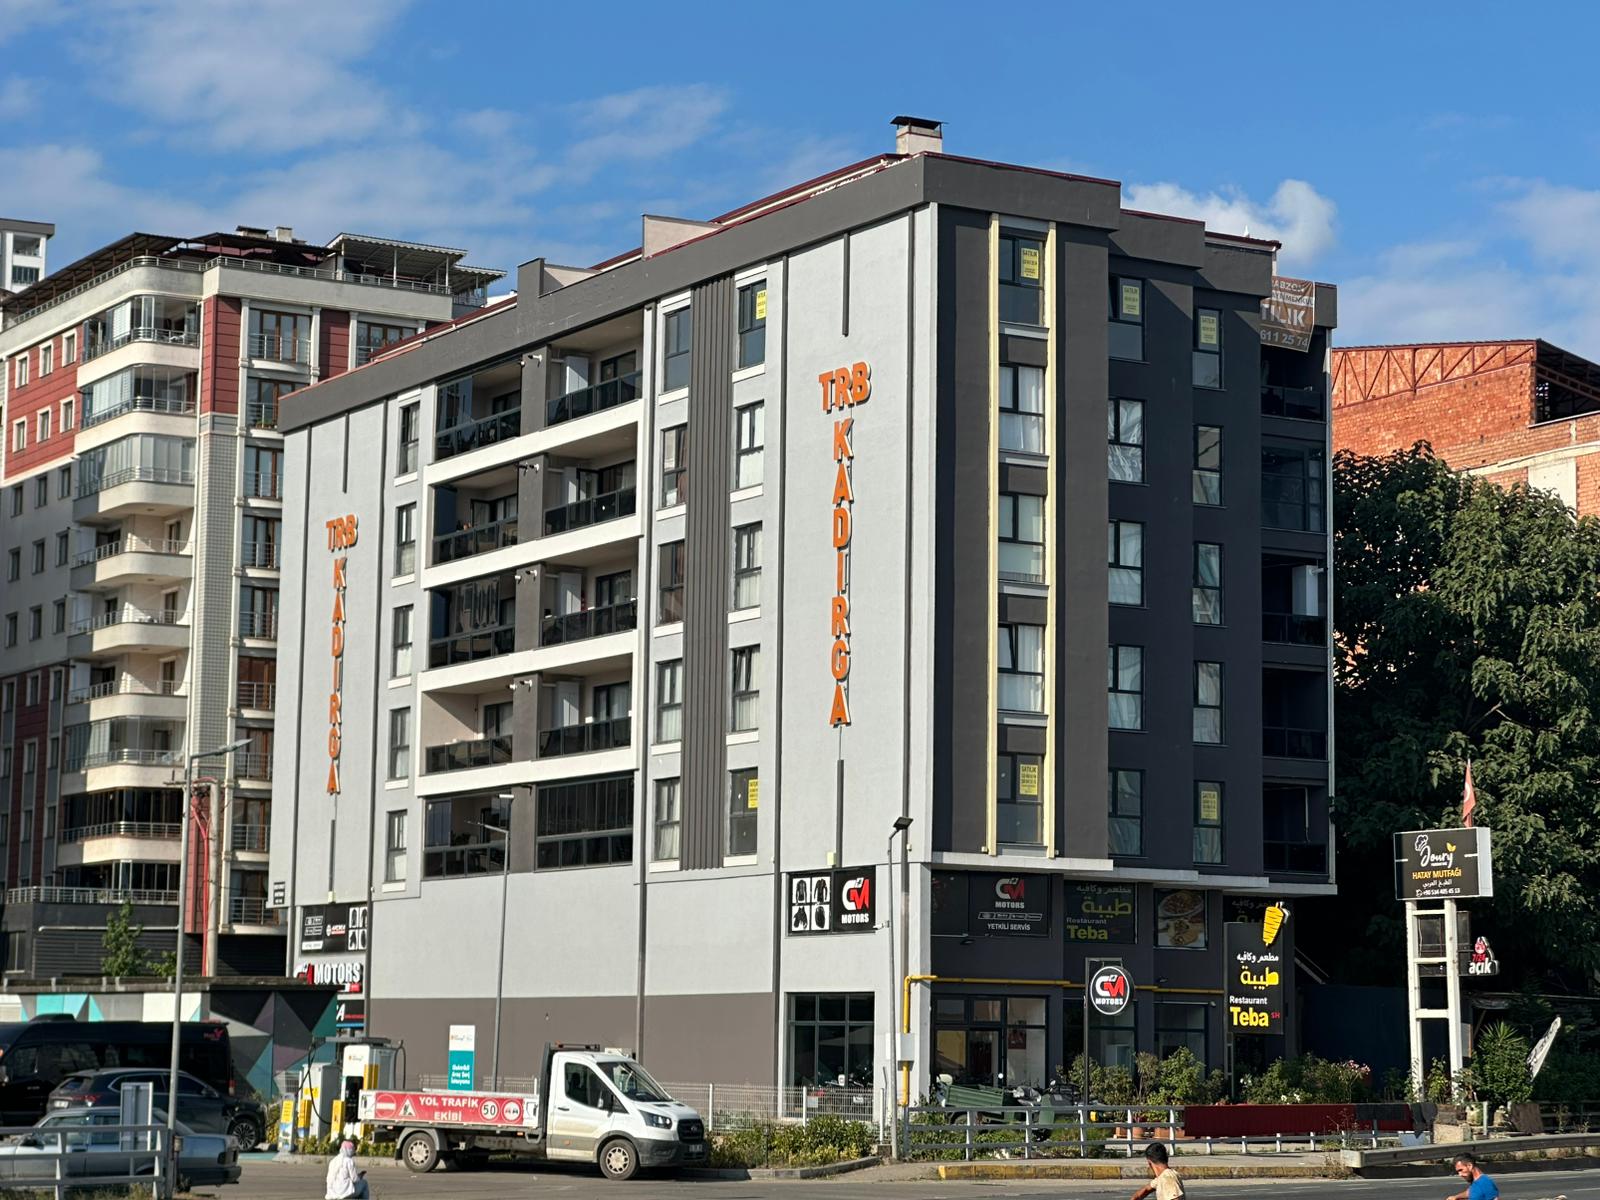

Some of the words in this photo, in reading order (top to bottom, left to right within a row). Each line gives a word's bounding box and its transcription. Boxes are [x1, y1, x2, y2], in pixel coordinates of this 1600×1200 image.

[818, 361, 871, 414] TRB
[326, 514, 359, 552] TRB
[830, 417, 854, 728] KADIRGA
[1412, 871, 1431, 879] HATAY
[995, 901, 1025, 909] MOTORS
[1082, 896, 1132, 918] طيبة
[841, 913, 869, 924] MOTORS
[1066, 917, 1107, 925] Restaurant
[1067, 925, 1108, 940] Teba
[1237, 951, 1256, 963] وكافيه
[1257, 953, 1279, 963] مطعم
[1469, 957, 1492, 975] açık
[313, 962, 361, 985] MOTORS
[1240, 966, 1279, 990] طيبة
[1095, 997, 1123, 1005] MOTORS
[1229, 995, 1267, 1004] Restaurant
[1230, 1006, 1269, 1027] Teba
[419, 1097, 439, 1107] YOL
[441, 1097, 479, 1108] TRAFİK
[434, 1110, 462, 1122] EKİBİ
[483, 1104, 496, 1116] 50
